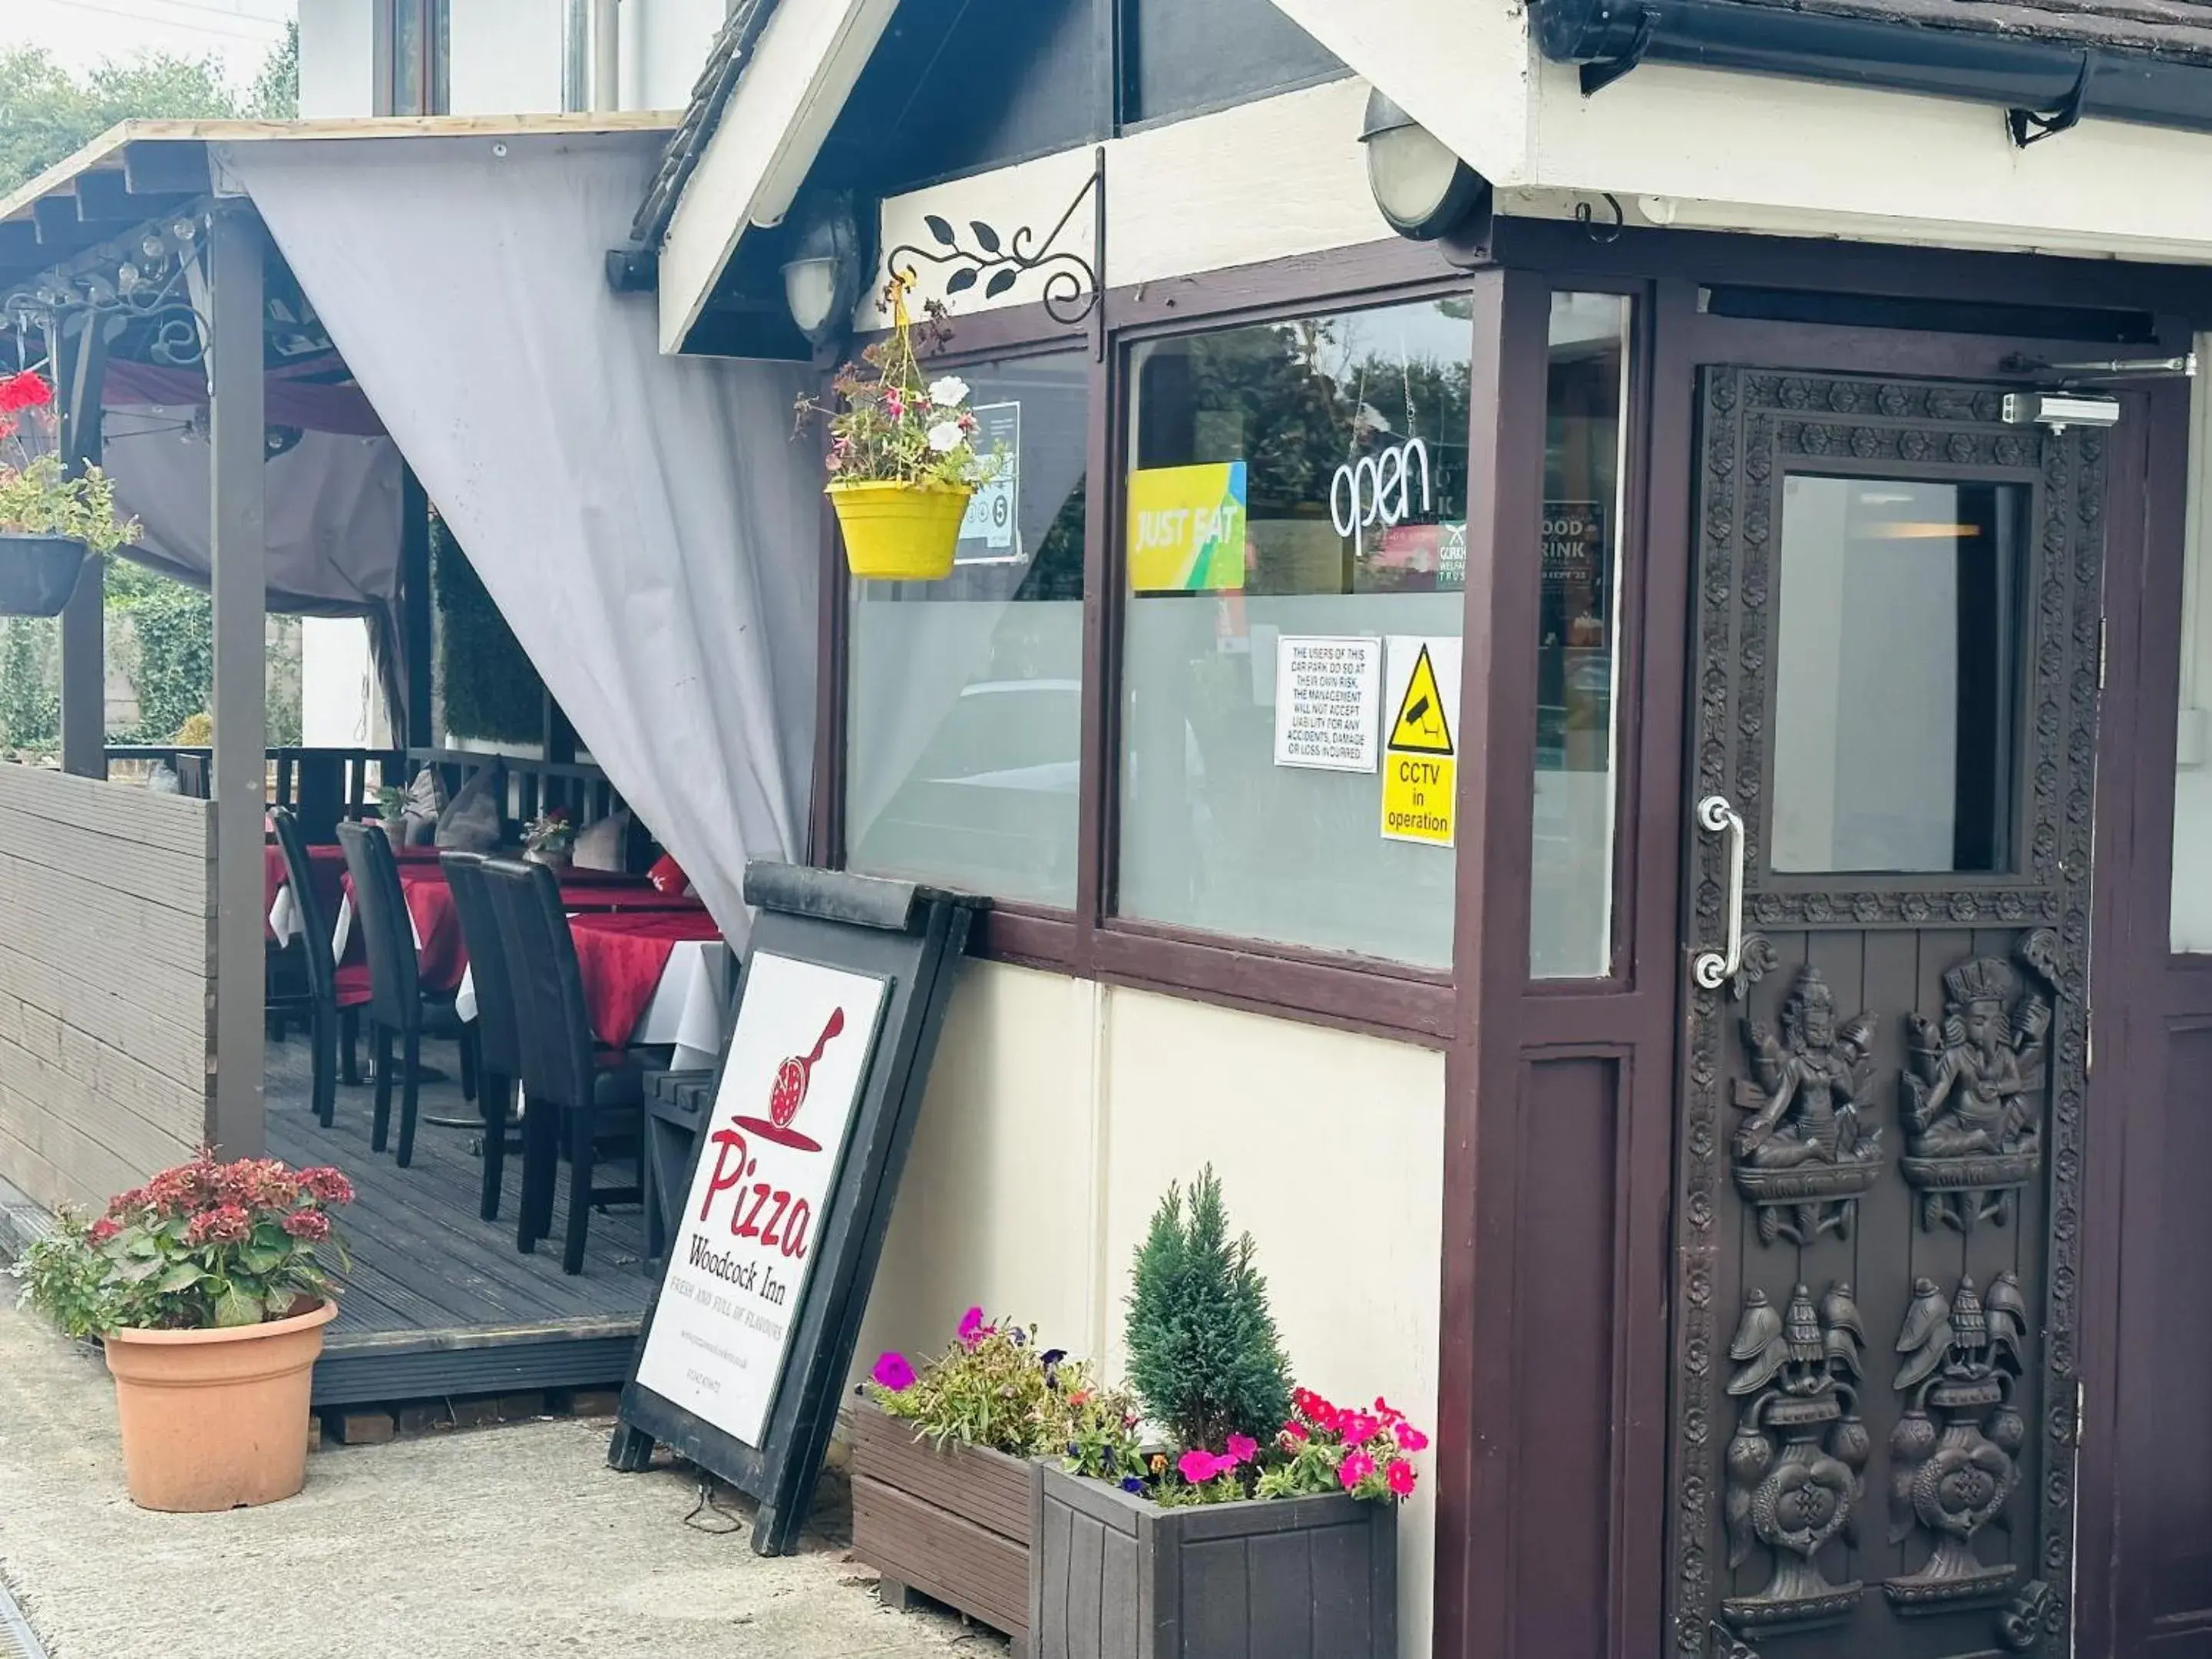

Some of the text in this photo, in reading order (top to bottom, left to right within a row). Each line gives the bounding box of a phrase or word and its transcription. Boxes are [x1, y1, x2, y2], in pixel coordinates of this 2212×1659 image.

[1331, 438, 1430, 557] open
[1136, 504, 1238, 553] JUST EAT
[1541, 520, 1583, 536] OOD
[1440, 546, 1466, 560] GURKH
[1541, 541, 1585, 558] RINK
[1440, 571, 1466, 582] TRUS
[1293, 647, 1365, 661] THE USERS OF THIS
[1291, 661, 1365, 674] CAR PARK DO SO AT
[1297, 675, 1318, 686] THEIR
[1319, 676, 1337, 687] OWN
[1293, 689, 1362, 702] THE MANAGEMENT
[1294, 703, 1360, 716] WILL NOT ACCEPT
[1293, 716, 1360, 730] LIABILITY FOR ANY
[1333, 732, 1365, 745] DAMAGE
[1288, 742, 1300, 754] OR
[1301, 744, 1321, 755] LOSS
[1400, 761, 1440, 785] CCTV
[1413, 788, 1424, 806] in
[1388, 811, 1447, 832] operation
[700, 1129, 812, 1260] Pizza
[689, 1234, 786, 1306] Woodcock Inn
